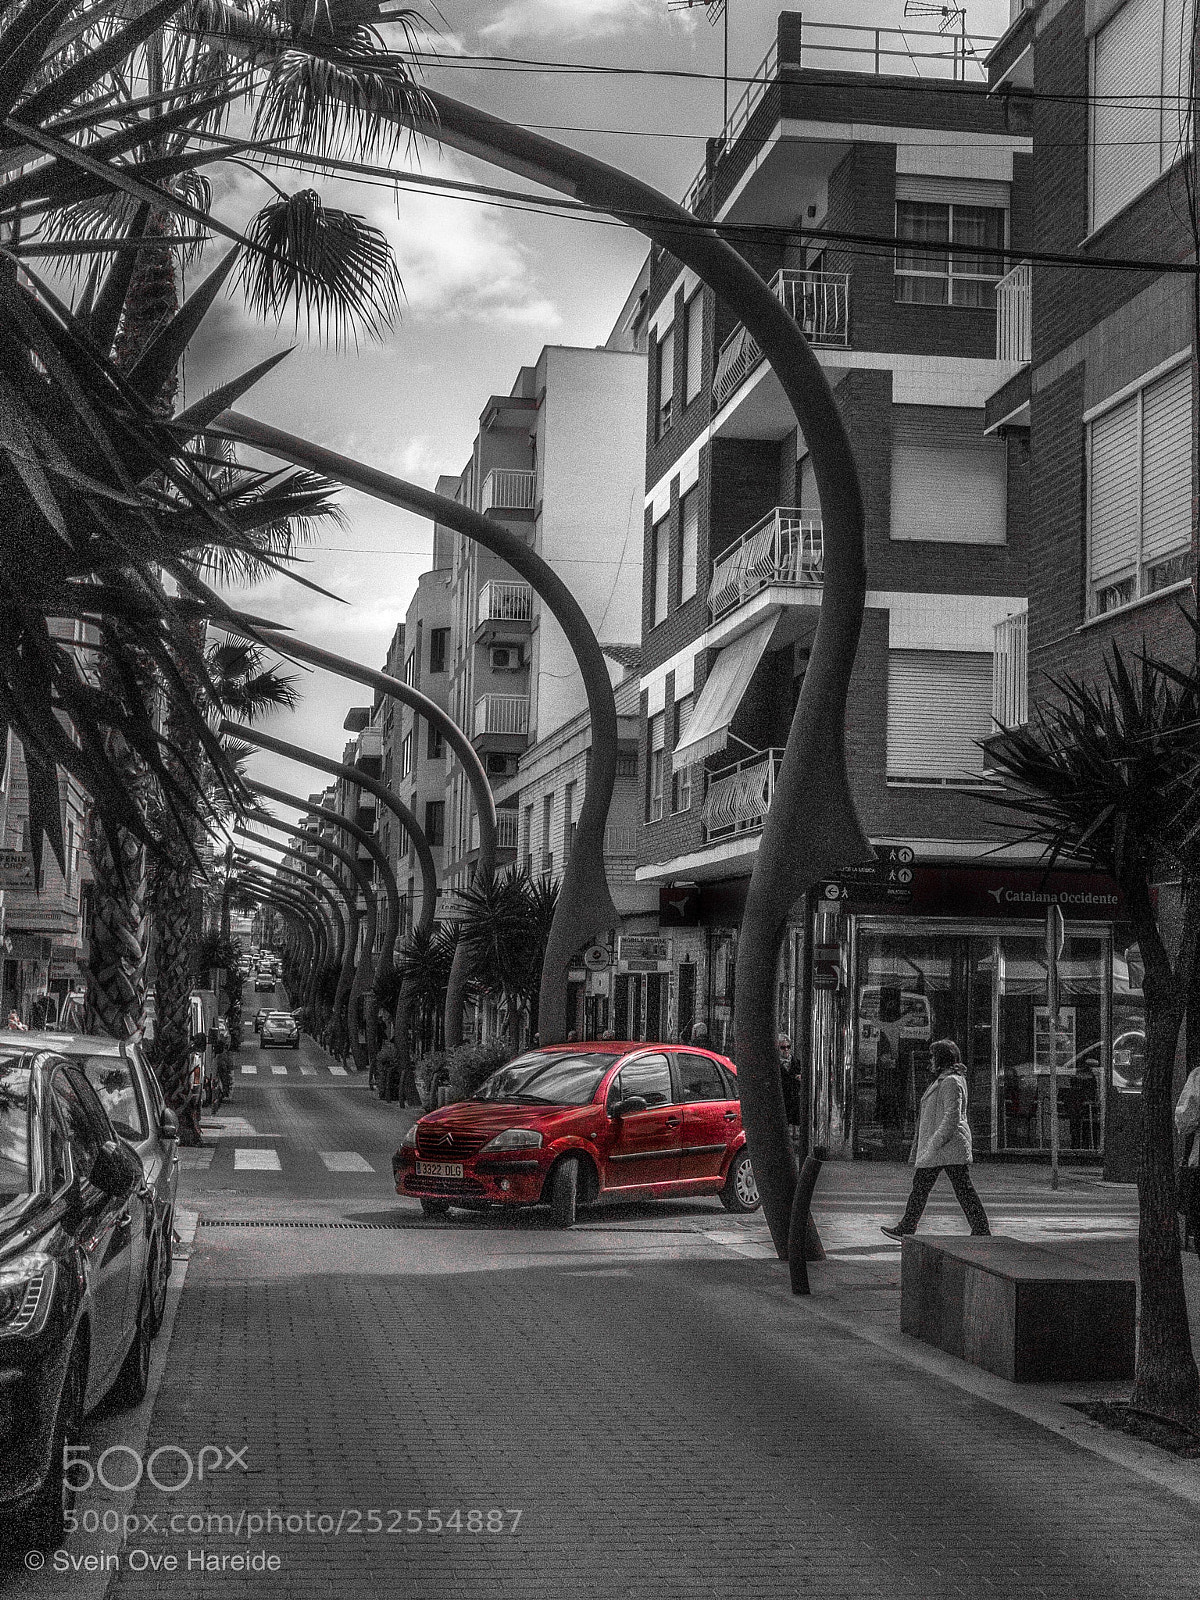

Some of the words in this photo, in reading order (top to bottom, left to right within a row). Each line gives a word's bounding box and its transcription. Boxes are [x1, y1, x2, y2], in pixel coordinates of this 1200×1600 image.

[1005, 890, 1058, 903] Catalana
[1060, 892, 1118, 905] Occidente
[422, 1163, 442, 1176] 3322
[445, 1165, 461, 1177] DLG
